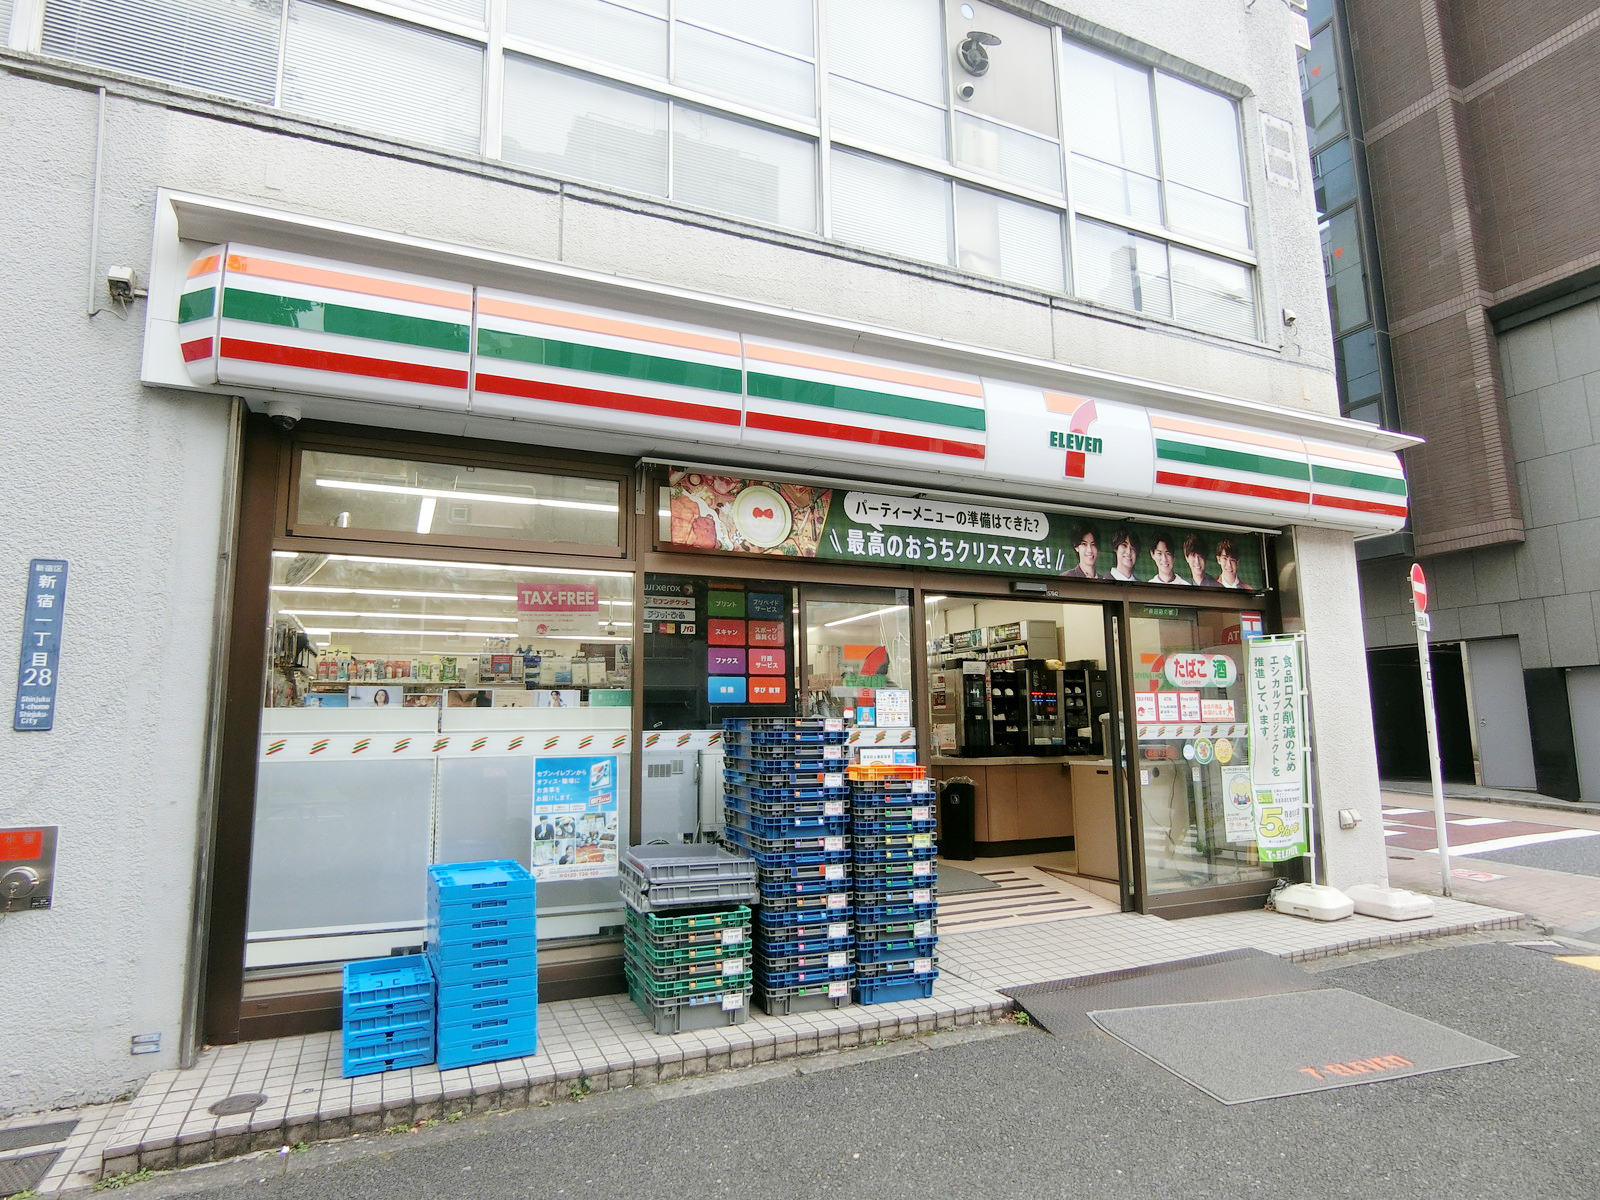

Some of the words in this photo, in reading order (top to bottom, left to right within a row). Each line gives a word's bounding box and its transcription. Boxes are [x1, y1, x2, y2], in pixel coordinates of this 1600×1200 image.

[855, 500, 1040, 533] パーティーメニューの準備はできた?
[846, 529, 1052, 571] 最高のおうちクリスマスを!
[35, 564, 63, 573] 新宿区
[521, 591, 595, 606] TAX-FREE
[653, 598, 690, 606] セブンチケット
[32, 575, 57, 667] 新宿一丁目
[648, 611, 686, 620] チケットぴあ
[23, 668, 52, 687] 28
[1174, 658, 1208, 678] たばこ
[1212, 659, 1228, 679] 酒
[753, 686, 766, 694] 学び
[20, 717, 38, 726] City
[1269, 656, 1281, 777] エシカルプロジェクトを
[1282, 655, 1297, 772] 食品ロス削減のため
